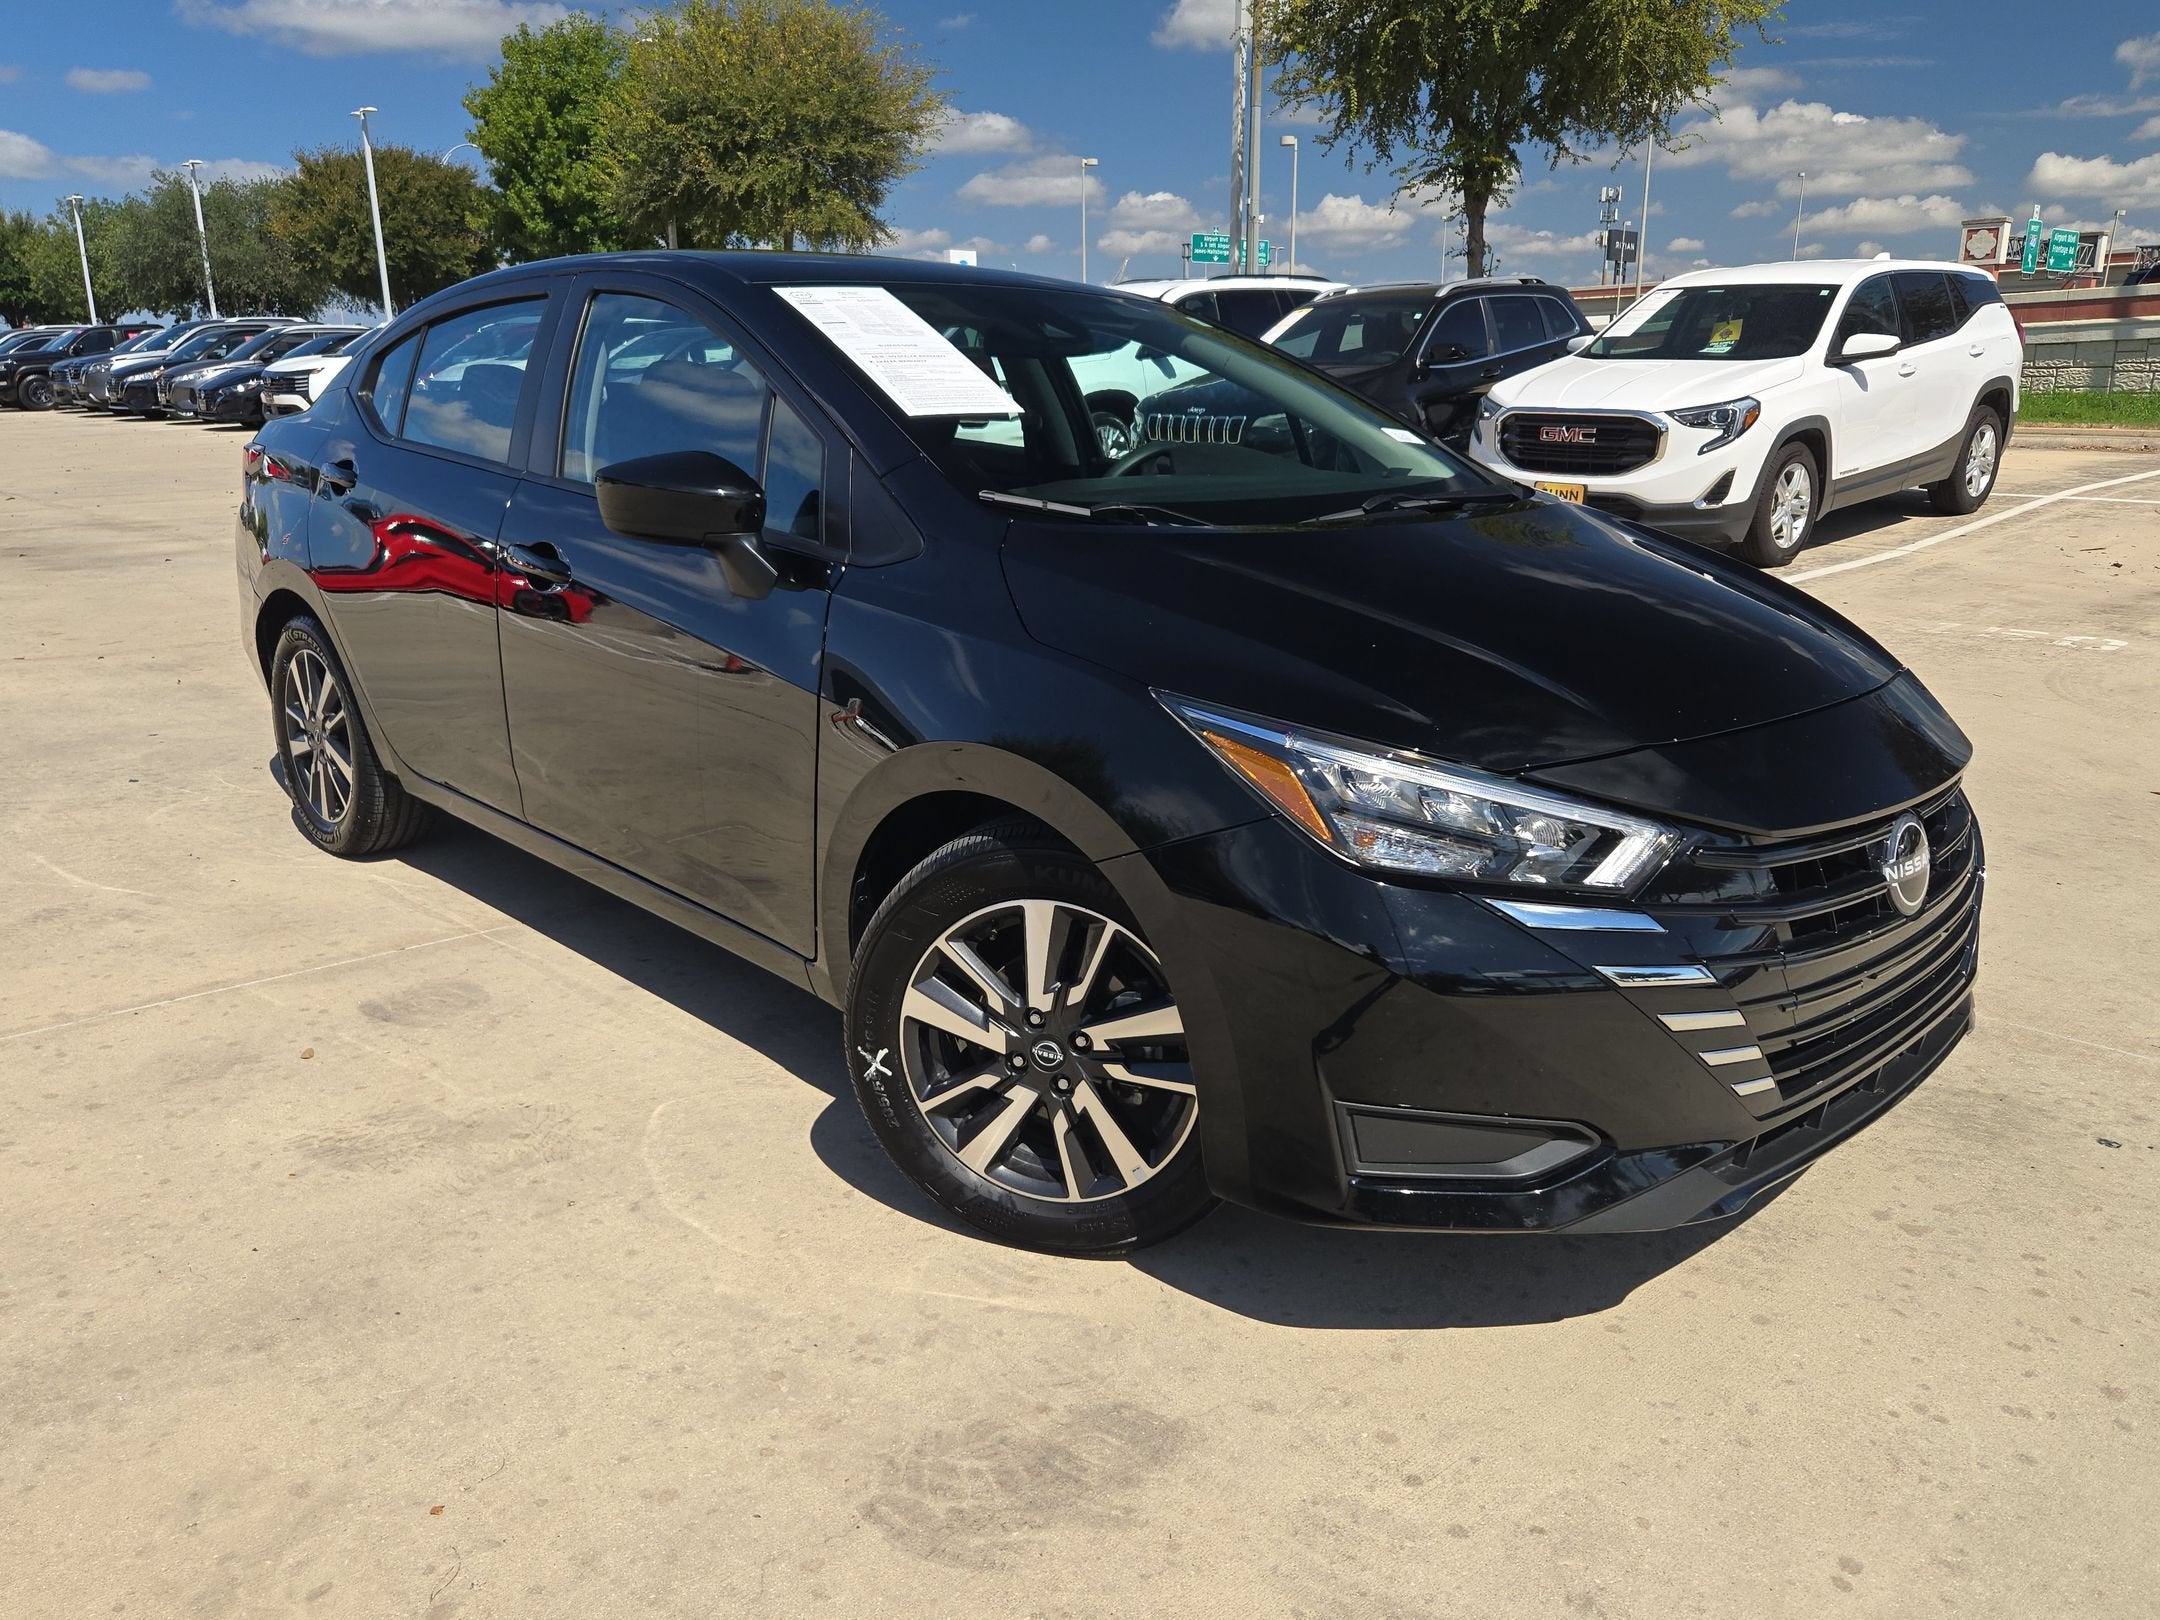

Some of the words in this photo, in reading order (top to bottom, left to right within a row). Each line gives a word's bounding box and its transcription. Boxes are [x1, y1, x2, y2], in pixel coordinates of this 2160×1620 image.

[2054, 233, 2067, 243] Airport
[2068, 235, 2077, 244] Blvd
[1194, 248, 1230, 256] Jones-Maltsberge
[2052, 245, 2068, 255] Frontage
[2069, 247, 2075, 255] Rd
[1539, 426, 1597, 443] GMC
[1034, 864, 1111, 896] KUM
[1032, 1047, 1064, 1061] NISSAN
